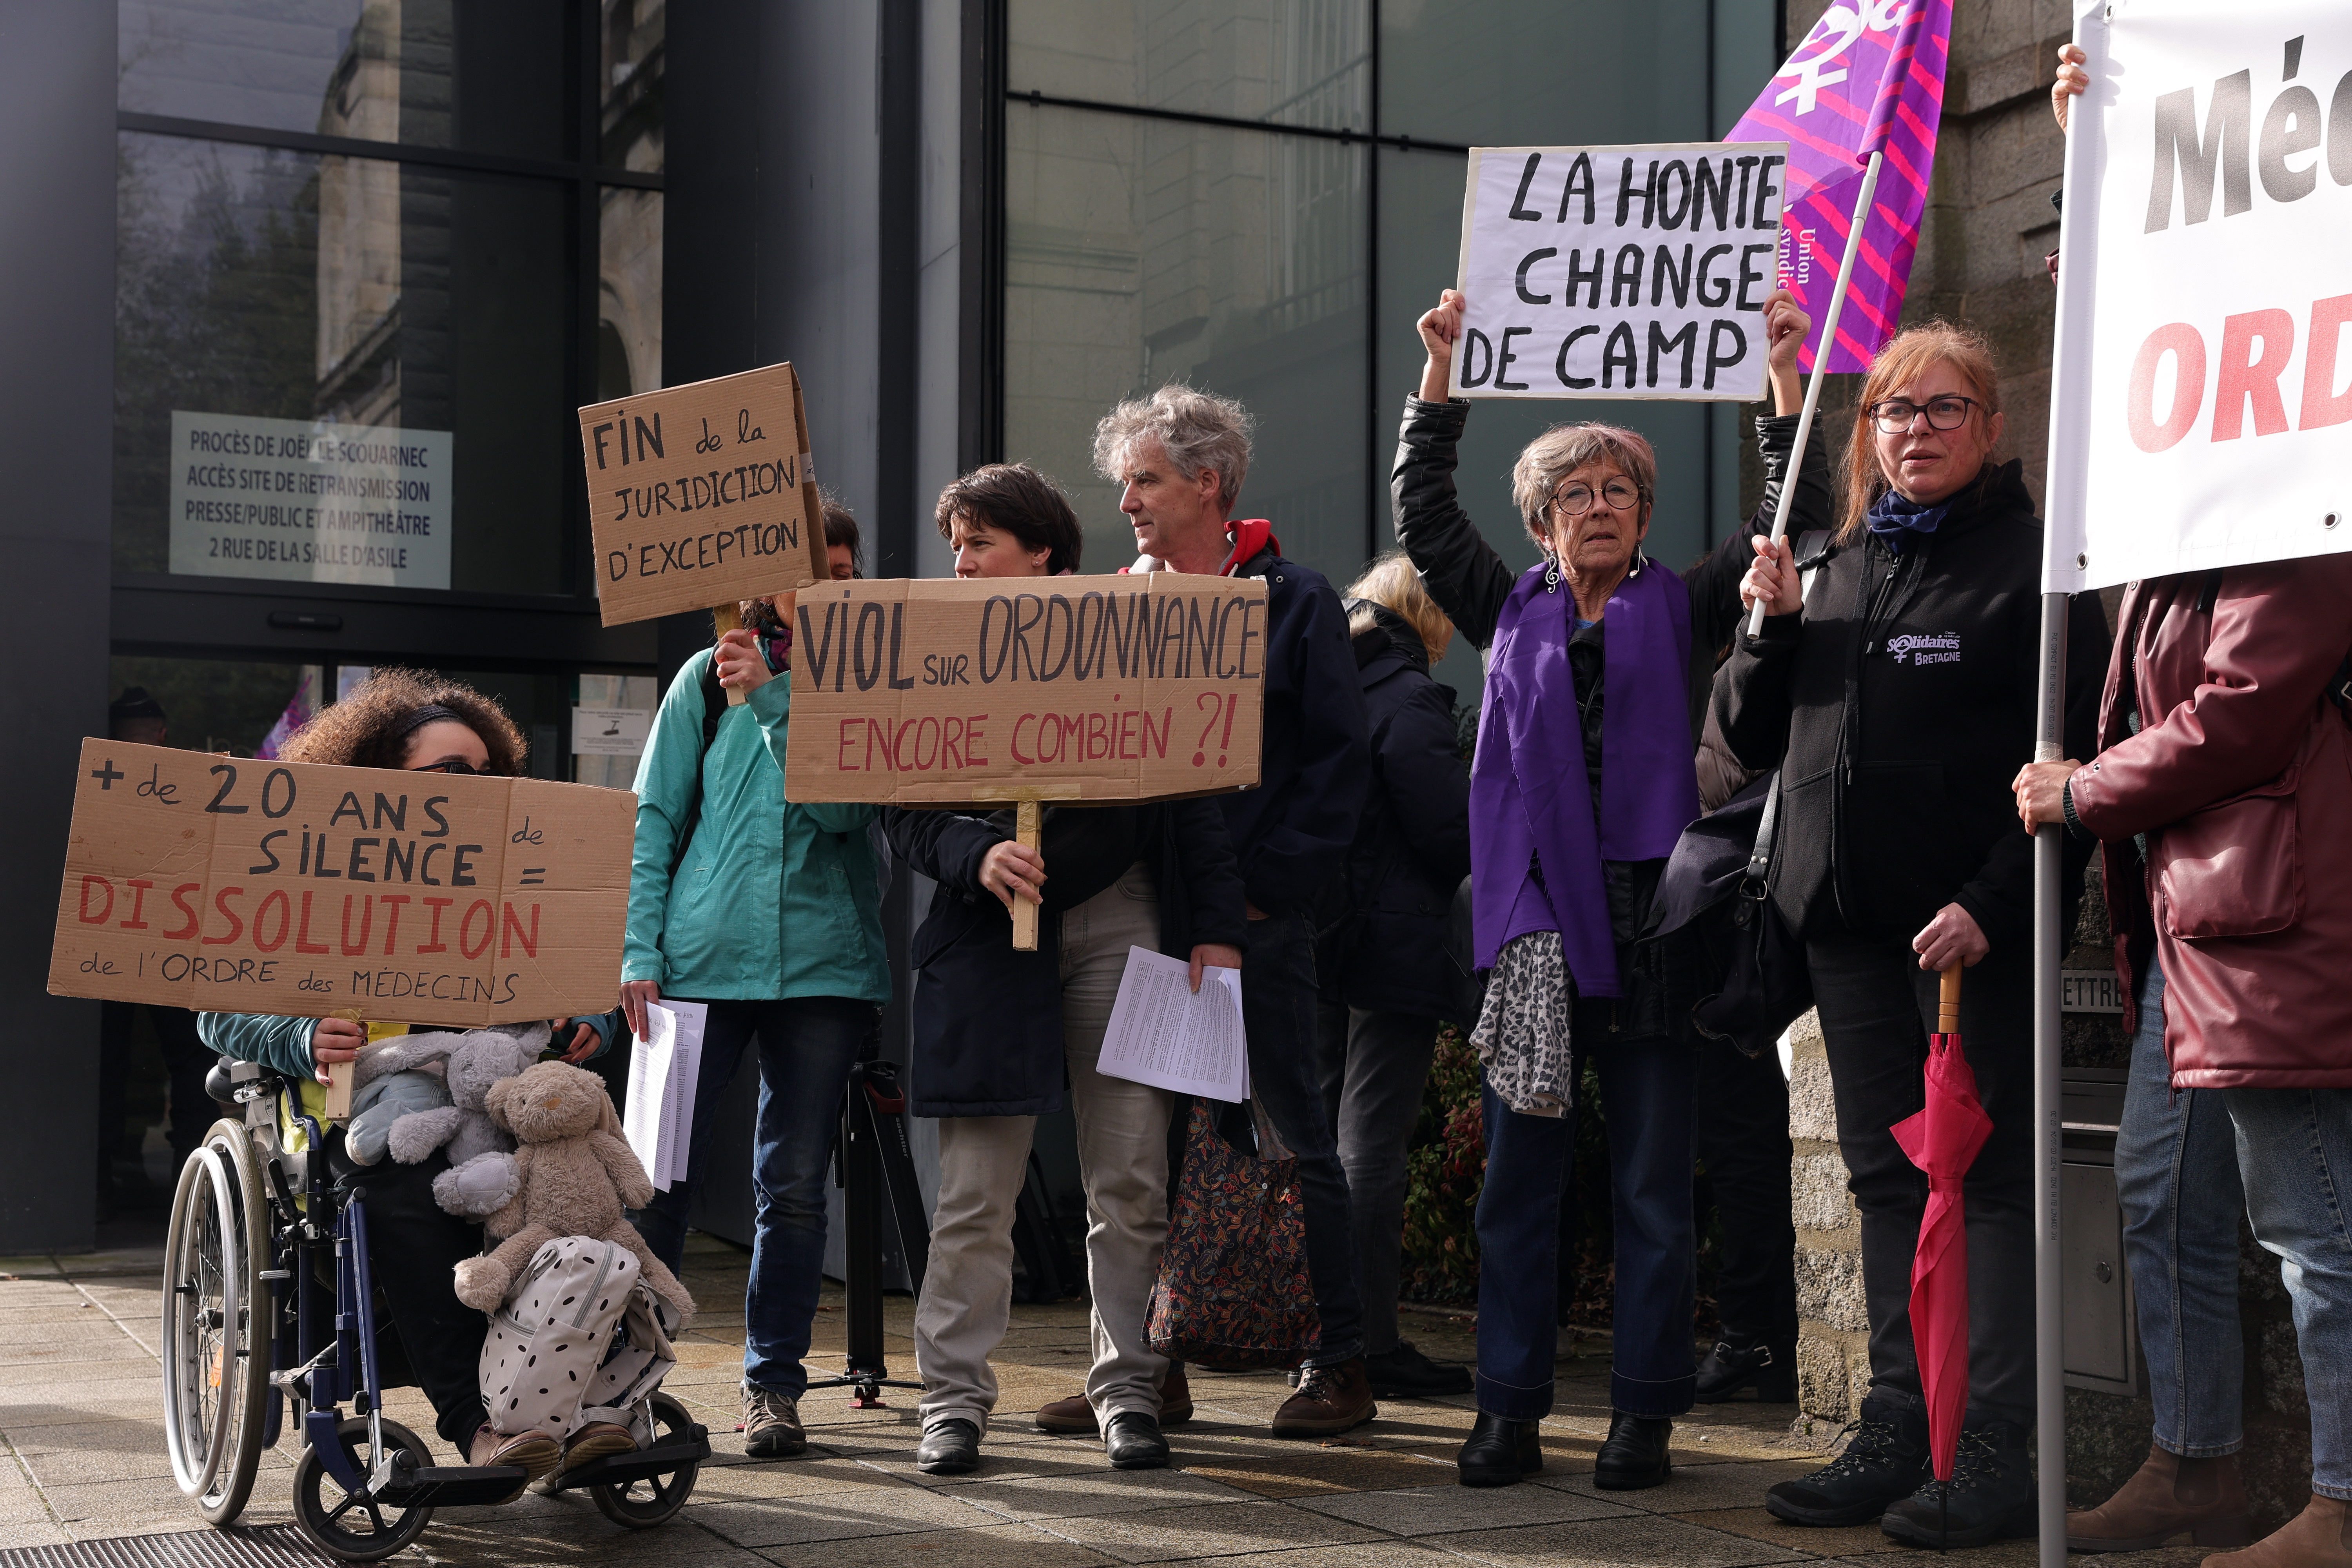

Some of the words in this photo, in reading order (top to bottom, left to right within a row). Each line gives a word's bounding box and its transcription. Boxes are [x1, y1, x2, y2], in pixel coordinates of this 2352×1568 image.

[1508, 151, 1595, 225] LA
[1615, 156, 1786, 232] HONTE
[1515, 243, 1773, 311] CHANGE
[1777, 228, 1795, 289] syndic
[1797, 227, 1816, 285] Union
[1461, 327, 1532, 390] DE
[1555, 319, 1747, 390] CAMP
[191, 430, 250, 455] PROCÈS
[255, 435, 274, 456] DE
[318, 440, 334, 461] LE
[338, 442, 427, 468] SCOUARNEC
[696, 417, 723, 454] de
[738, 409, 767, 445] la
[187, 463, 235, 488] ACCÈS
[240, 469, 270, 491] SITE
[276, 472, 295, 492] DE
[299, 474, 430, 502] RETRANSMISSION
[615, 456, 795, 521] JURIDICTION
[186, 500, 301, 528] PRESSE/PUBLIC
[307, 508, 321, 528] ET
[209, 537, 218, 557] 2
[223, 539, 252, 559] RUE
[257, 540, 276, 560] DE
[281, 541, 299, 562] LA
[304, 543, 348, 564] SALLE
[353, 546, 407, 568] D'ASILE
[608, 519, 798, 582] D'EXCEPTION
[979, 591, 1265, 684] ORDONNANCE
[838, 713, 989, 771] ENCORE
[1191, 691, 1238, 768] ?!
[91, 760, 124, 789] +
[137, 763, 181, 804] de
[205, 764, 296, 818] 20
[330, 791, 449, 838] ANS
[512, 816, 544, 845] de
[78, 875, 541, 960] DISSOLUTION
[80, 953, 123, 975] de
[298, 971, 333, 993] des
[352, 966, 520, 1004] MÉDECINS
[896, 1117, 909, 1158] sachtler
